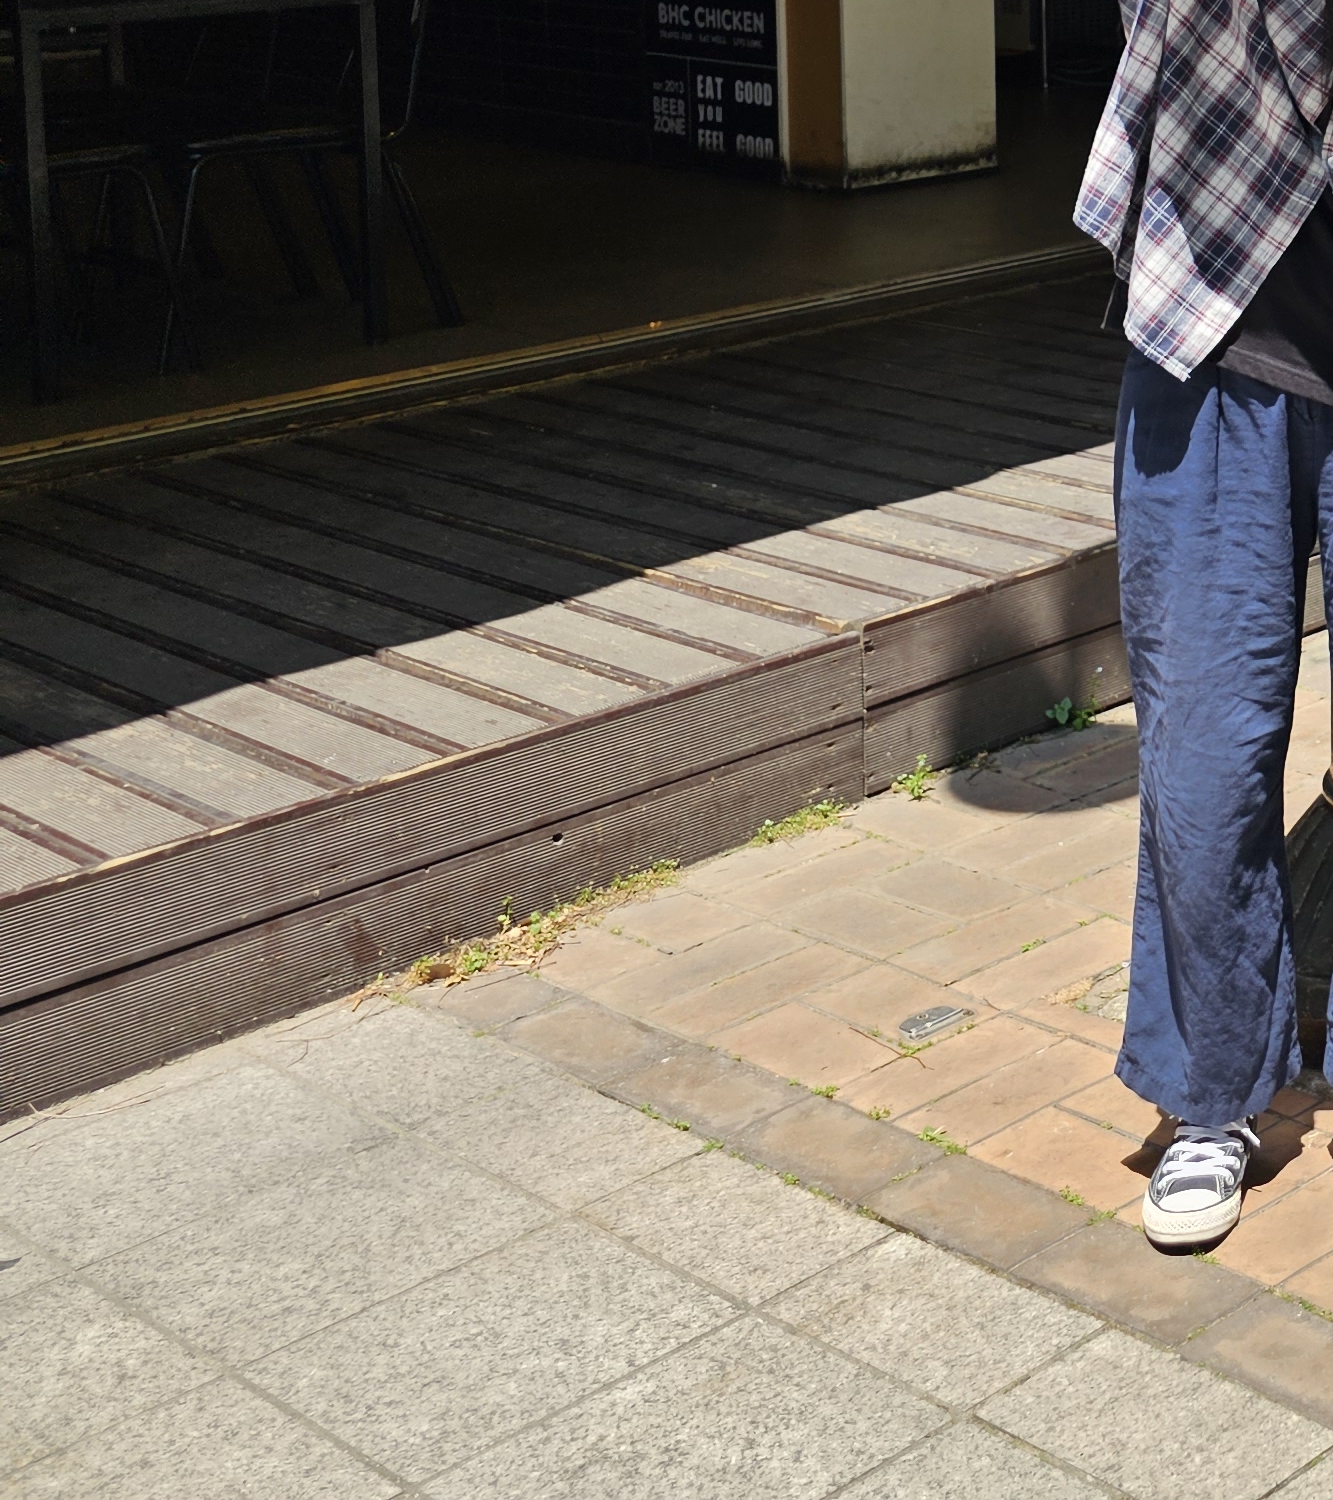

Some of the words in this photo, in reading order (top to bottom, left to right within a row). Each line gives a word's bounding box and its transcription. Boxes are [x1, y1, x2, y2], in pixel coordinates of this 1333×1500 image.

[657, 2, 690, 27] BHC
[694, 5, 765, 34] CHICKEN
[696, 74, 723, 100] EAT
[734, 79, 773, 107] GOOD
[652, 95, 686, 117] BEER
[698, 103, 723, 123] YOU
[653, 114, 687, 136] ZONE
[735, 133, 774, 160] GOOD
